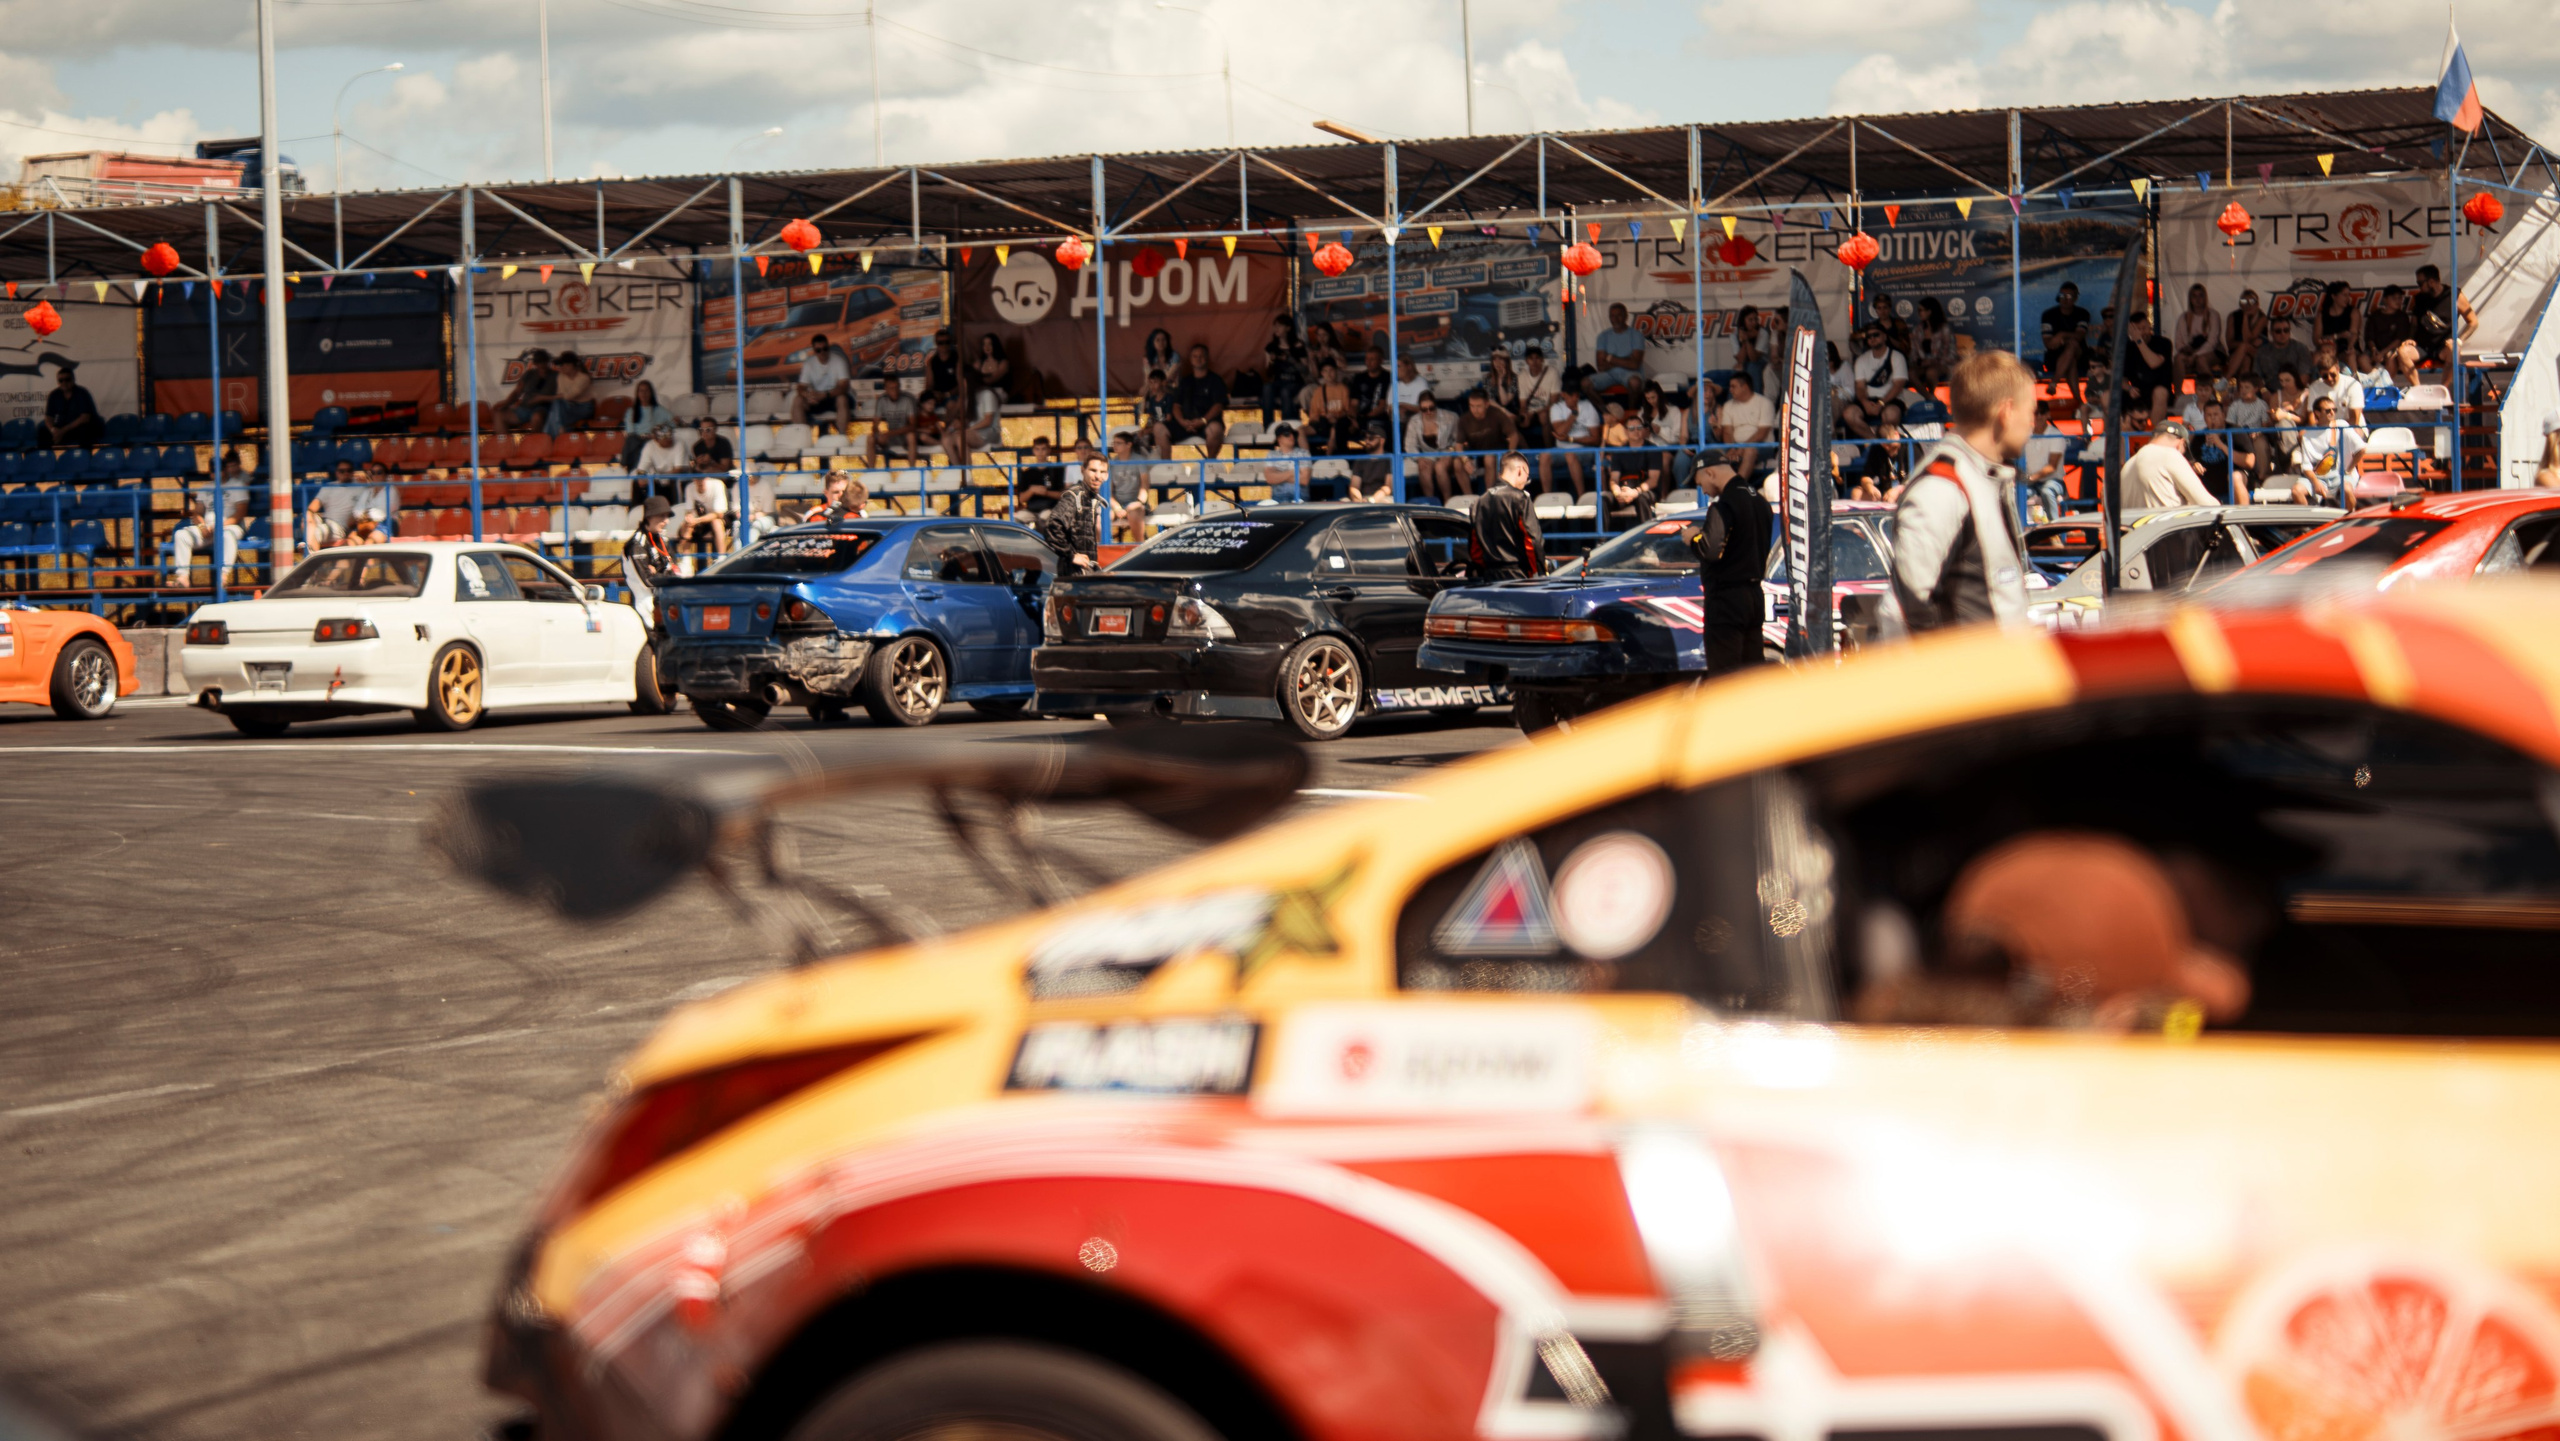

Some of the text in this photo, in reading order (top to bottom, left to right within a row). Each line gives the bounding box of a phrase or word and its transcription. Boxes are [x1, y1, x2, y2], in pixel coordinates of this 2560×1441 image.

[1878, 229, 1977, 262] ОТПУСК
[2332, 248, 2388, 259] TEAM
[472, 281, 684, 318] STROKER
